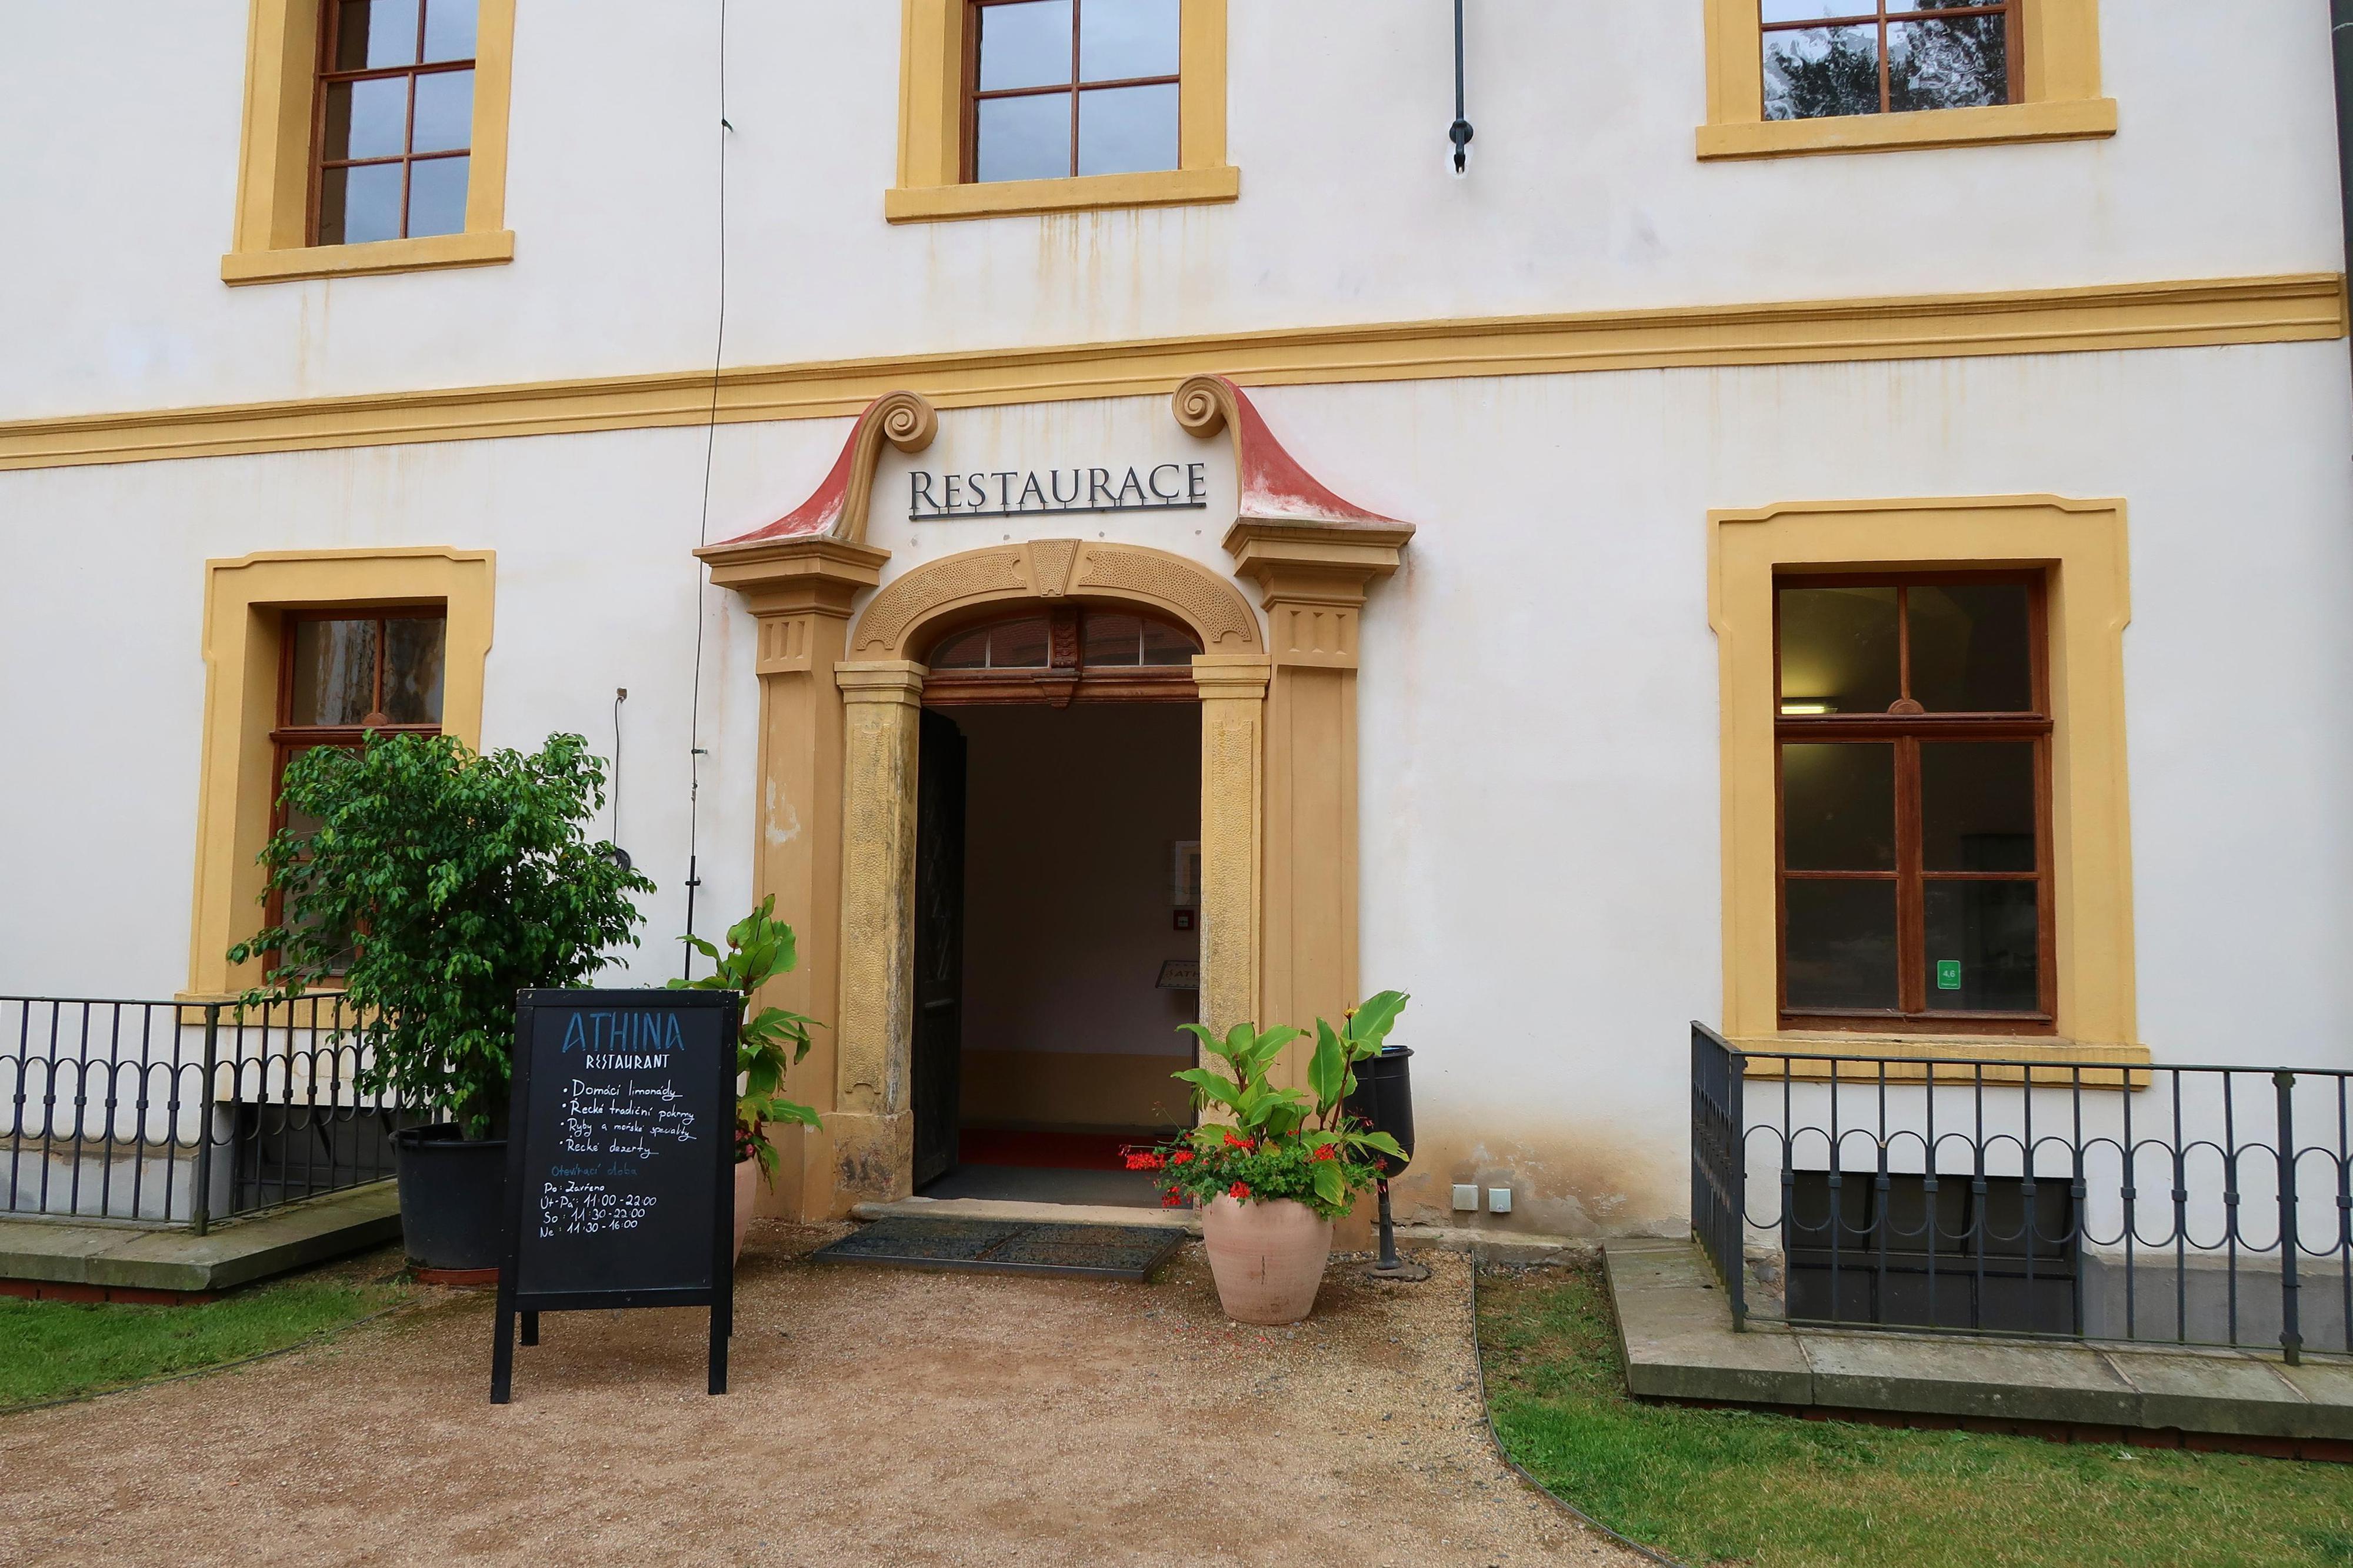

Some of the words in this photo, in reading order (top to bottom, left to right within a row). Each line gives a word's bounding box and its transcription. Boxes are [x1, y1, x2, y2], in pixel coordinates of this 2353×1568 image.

[908, 462, 1208, 511] RESTAURACE
[562, 1012, 685, 1053] ATHINA
[586, 1055, 670, 1069] RESTAURANT
[572, 1079, 621, 1097] Domácí
[628, 1079, 684, 1102] limonády
[658, 1104, 695, 1125] pokrmy
[566, 1118, 592, 1137] Ryby
[601, 1123, 608, 1132] a
[609, 1136, 659, 1159] dezerty
[607, 1160, 638, 1176] doba
